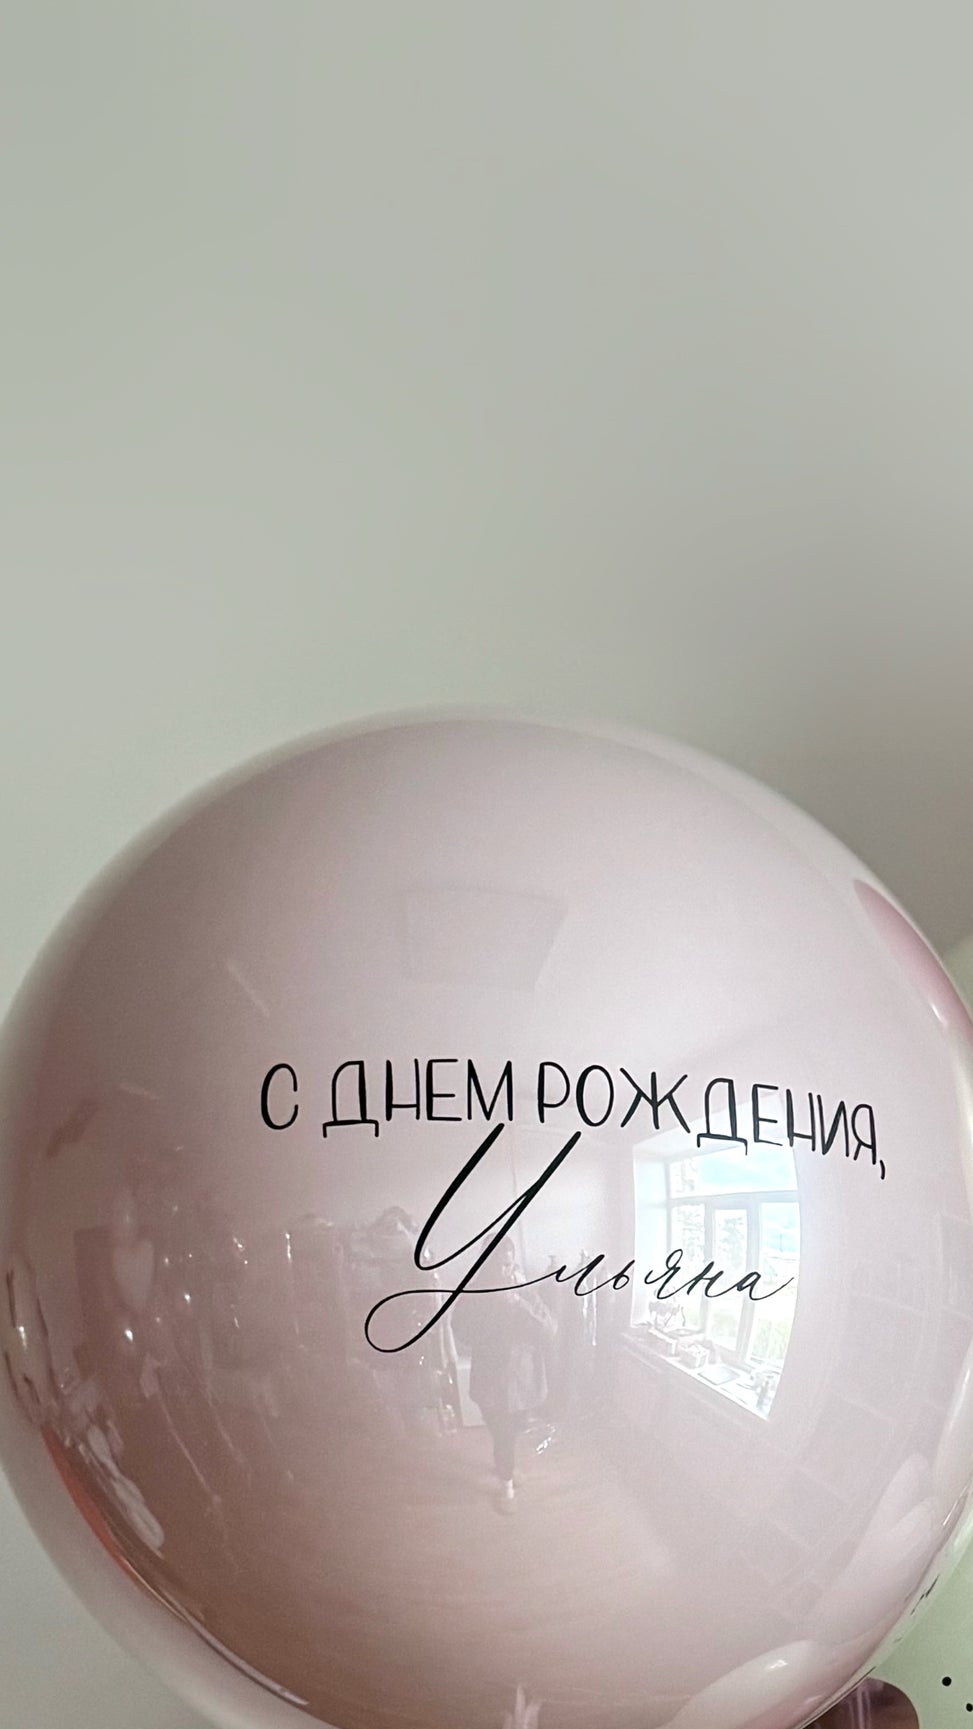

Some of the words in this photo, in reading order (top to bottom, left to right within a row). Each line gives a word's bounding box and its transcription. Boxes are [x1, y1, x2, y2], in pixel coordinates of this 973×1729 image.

[260, 1062, 299, 1131] С
[322, 1058, 515, 1139] ДНЕМ
[536, 1061, 887, 1180] РОЖДЕНИЯ,
[364, 1122, 795, 1354] Ульяна
